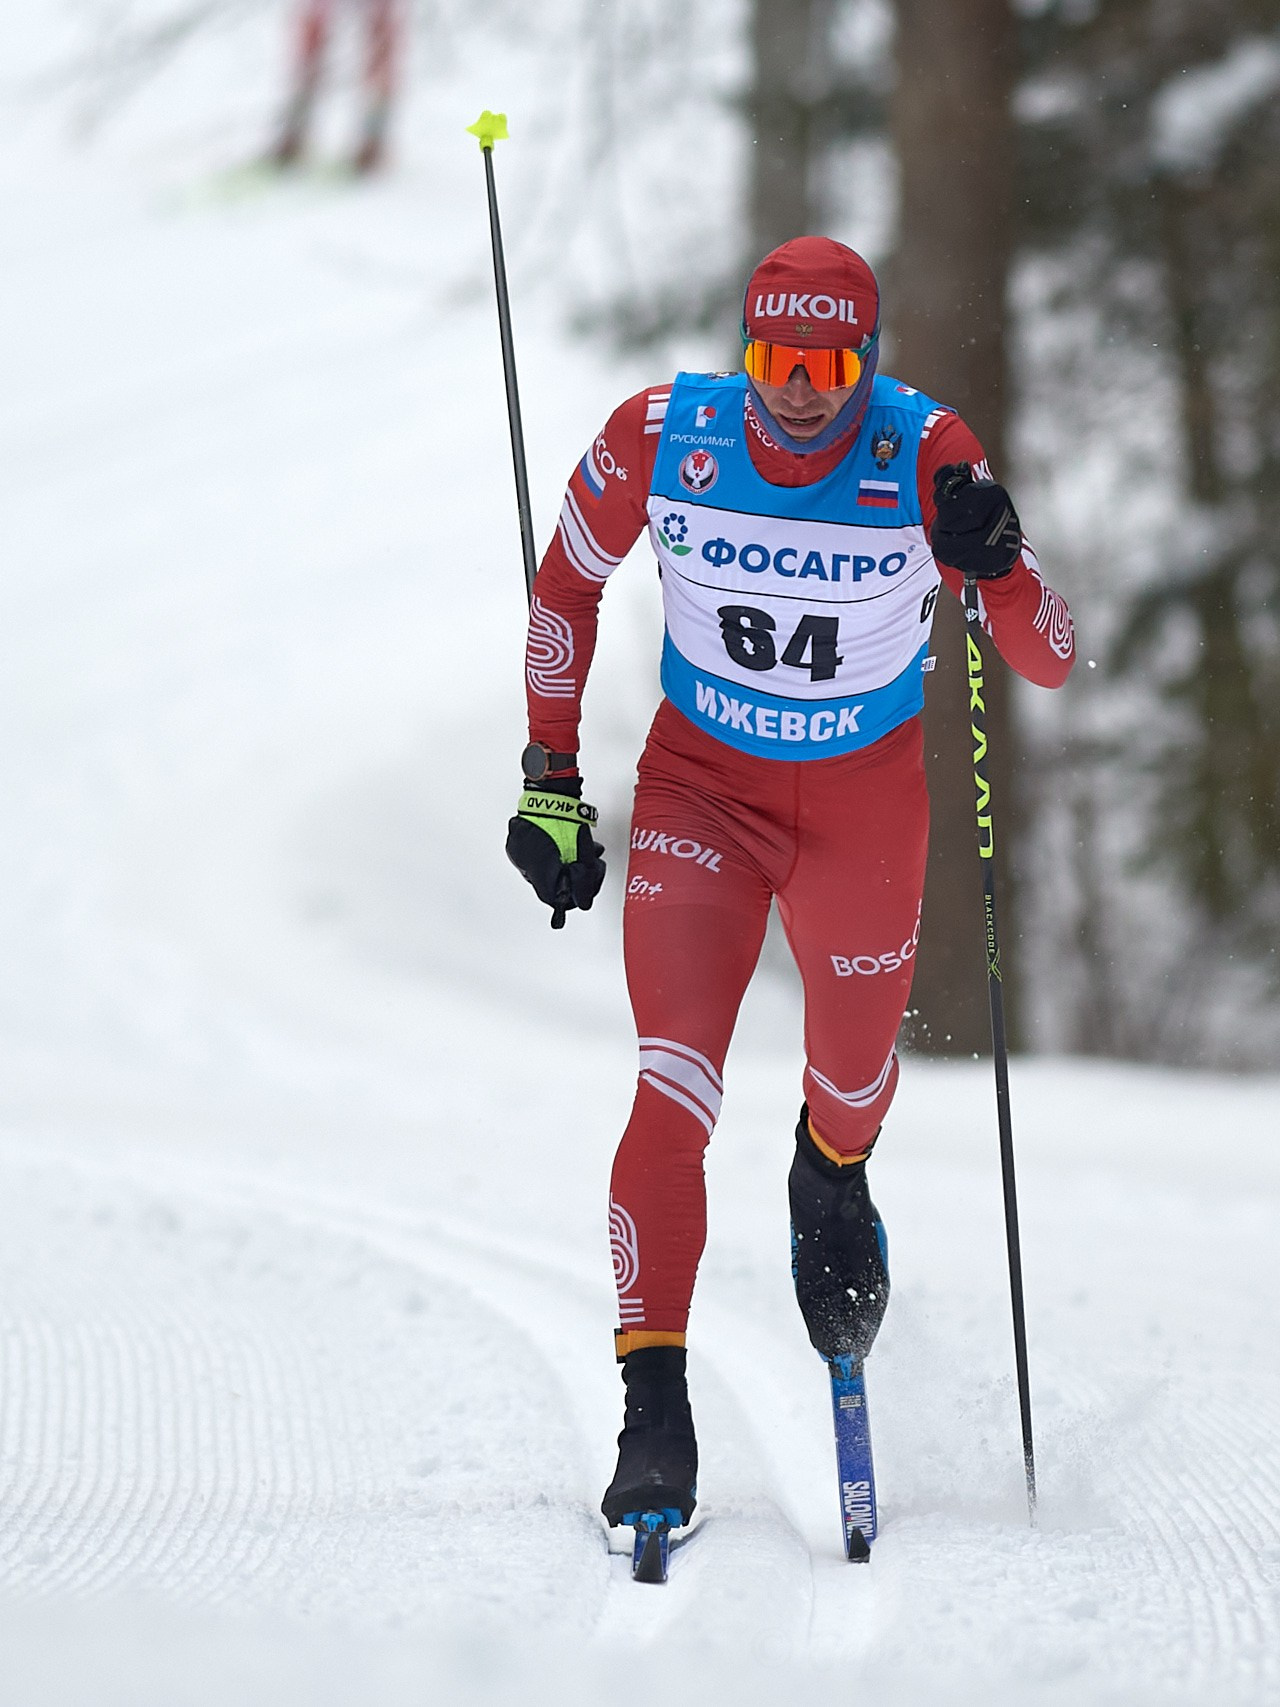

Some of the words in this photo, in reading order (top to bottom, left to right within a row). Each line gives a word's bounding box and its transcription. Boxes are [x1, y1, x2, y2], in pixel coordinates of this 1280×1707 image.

[755, 293, 858, 325] LUKOIL
[669, 433, 737, 448] РУСКЛИМАТ
[701, 537, 907, 583] ФОСАГРО
[716, 604, 844, 683] 64
[694, 680, 865, 742] ИЖЕВСК
[631, 827, 723, 873] LUKOIL
[628, 875, 663, 895] En+
